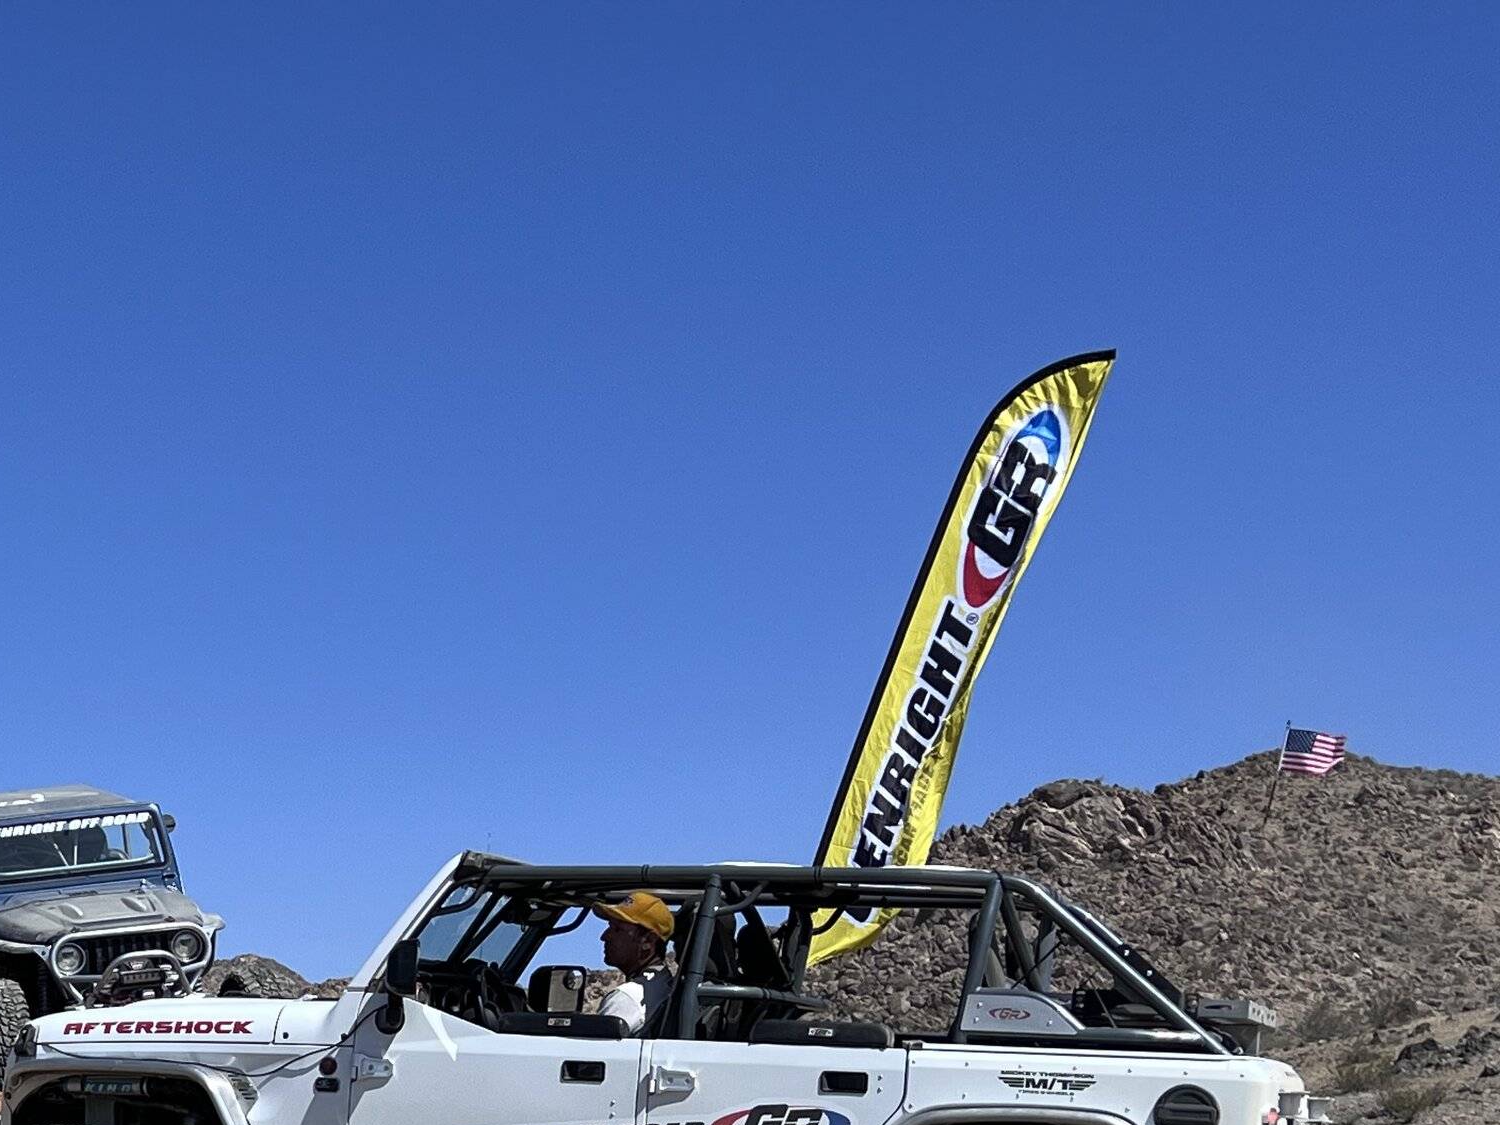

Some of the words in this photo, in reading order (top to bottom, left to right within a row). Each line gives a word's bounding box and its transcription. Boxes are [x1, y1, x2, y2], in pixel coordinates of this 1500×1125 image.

[967, 439, 1057, 568] GR
[846, 600, 975, 921] ENRIGHT
[68, 817, 101, 831] OFF
[100, 812, 151, 827] ROAD
[63, 1020, 254, 1035] AFTERSHOCK
[1025, 1078, 1074, 1090] M/T
